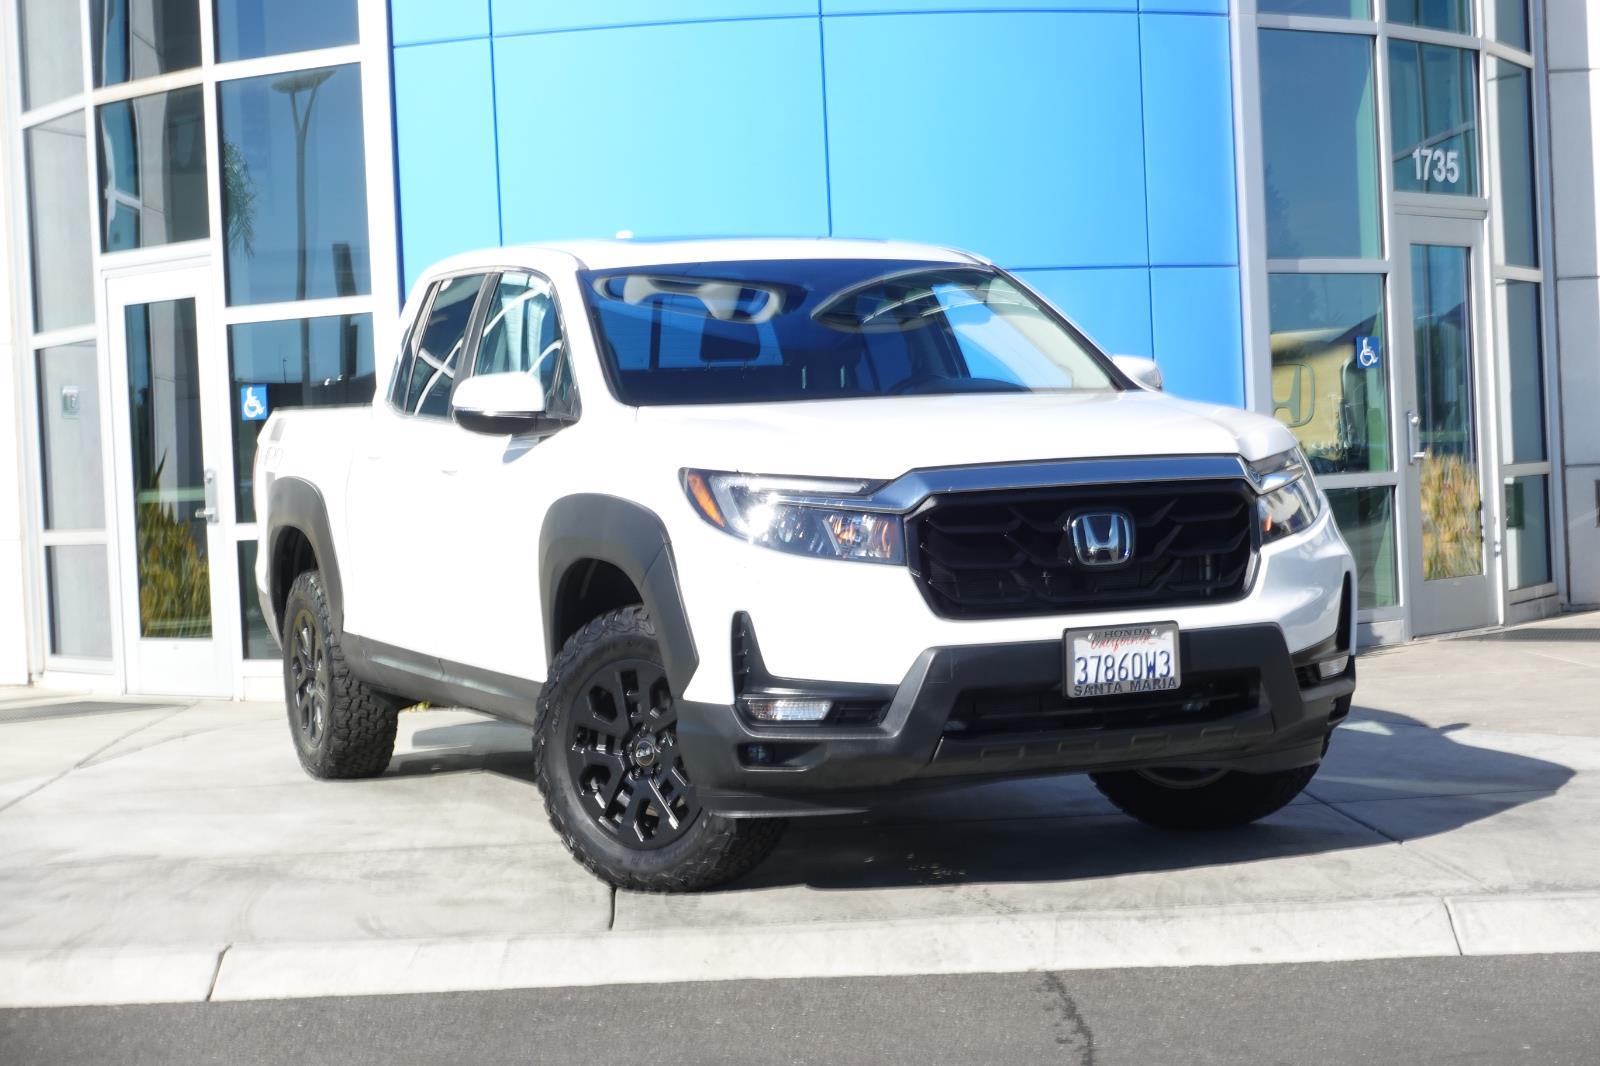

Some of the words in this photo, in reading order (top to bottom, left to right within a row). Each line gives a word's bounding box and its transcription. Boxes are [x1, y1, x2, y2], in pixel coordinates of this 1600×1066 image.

[1412, 147, 1459, 183] 1735
[1104, 628, 1151, 638] HONDA
[1075, 650, 1170, 685] 37860W3
[1074, 681, 1122, 696] SANTA
[1129, 677, 1177, 692] MARIA
